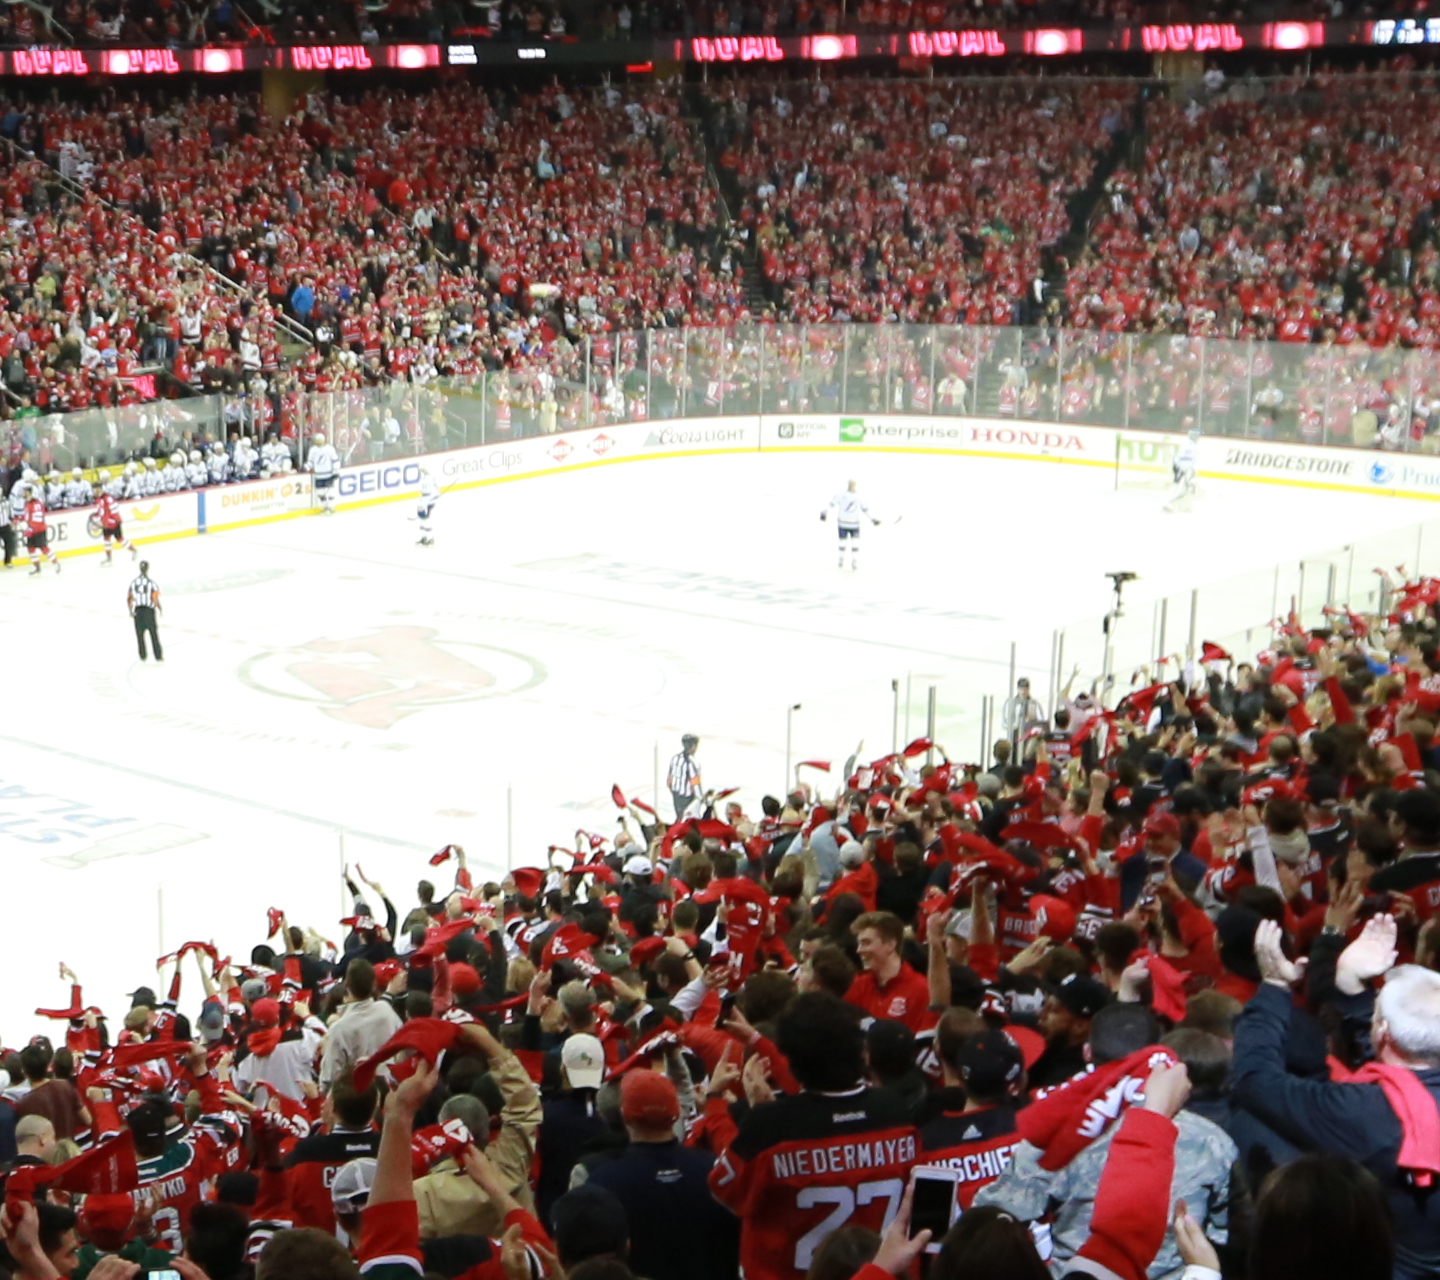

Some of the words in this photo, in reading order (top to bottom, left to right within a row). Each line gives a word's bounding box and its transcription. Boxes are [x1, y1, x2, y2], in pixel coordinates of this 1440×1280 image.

[704, 427, 746, 443] LIGHT
[844, 422, 960, 442] enterprise
[969, 426, 1086, 451] HONDA
[442, 455, 485, 478] Great
[488, 451, 523, 473] Clips
[1224, 447, 1355, 477] BRIDGESTONE
[337, 463, 422, 498] GEICO
[221, 485, 279, 510] DUNKIN'
[772, 1134, 917, 1180] NIEDERMAYER
[793, 1177, 904, 1271] 27
